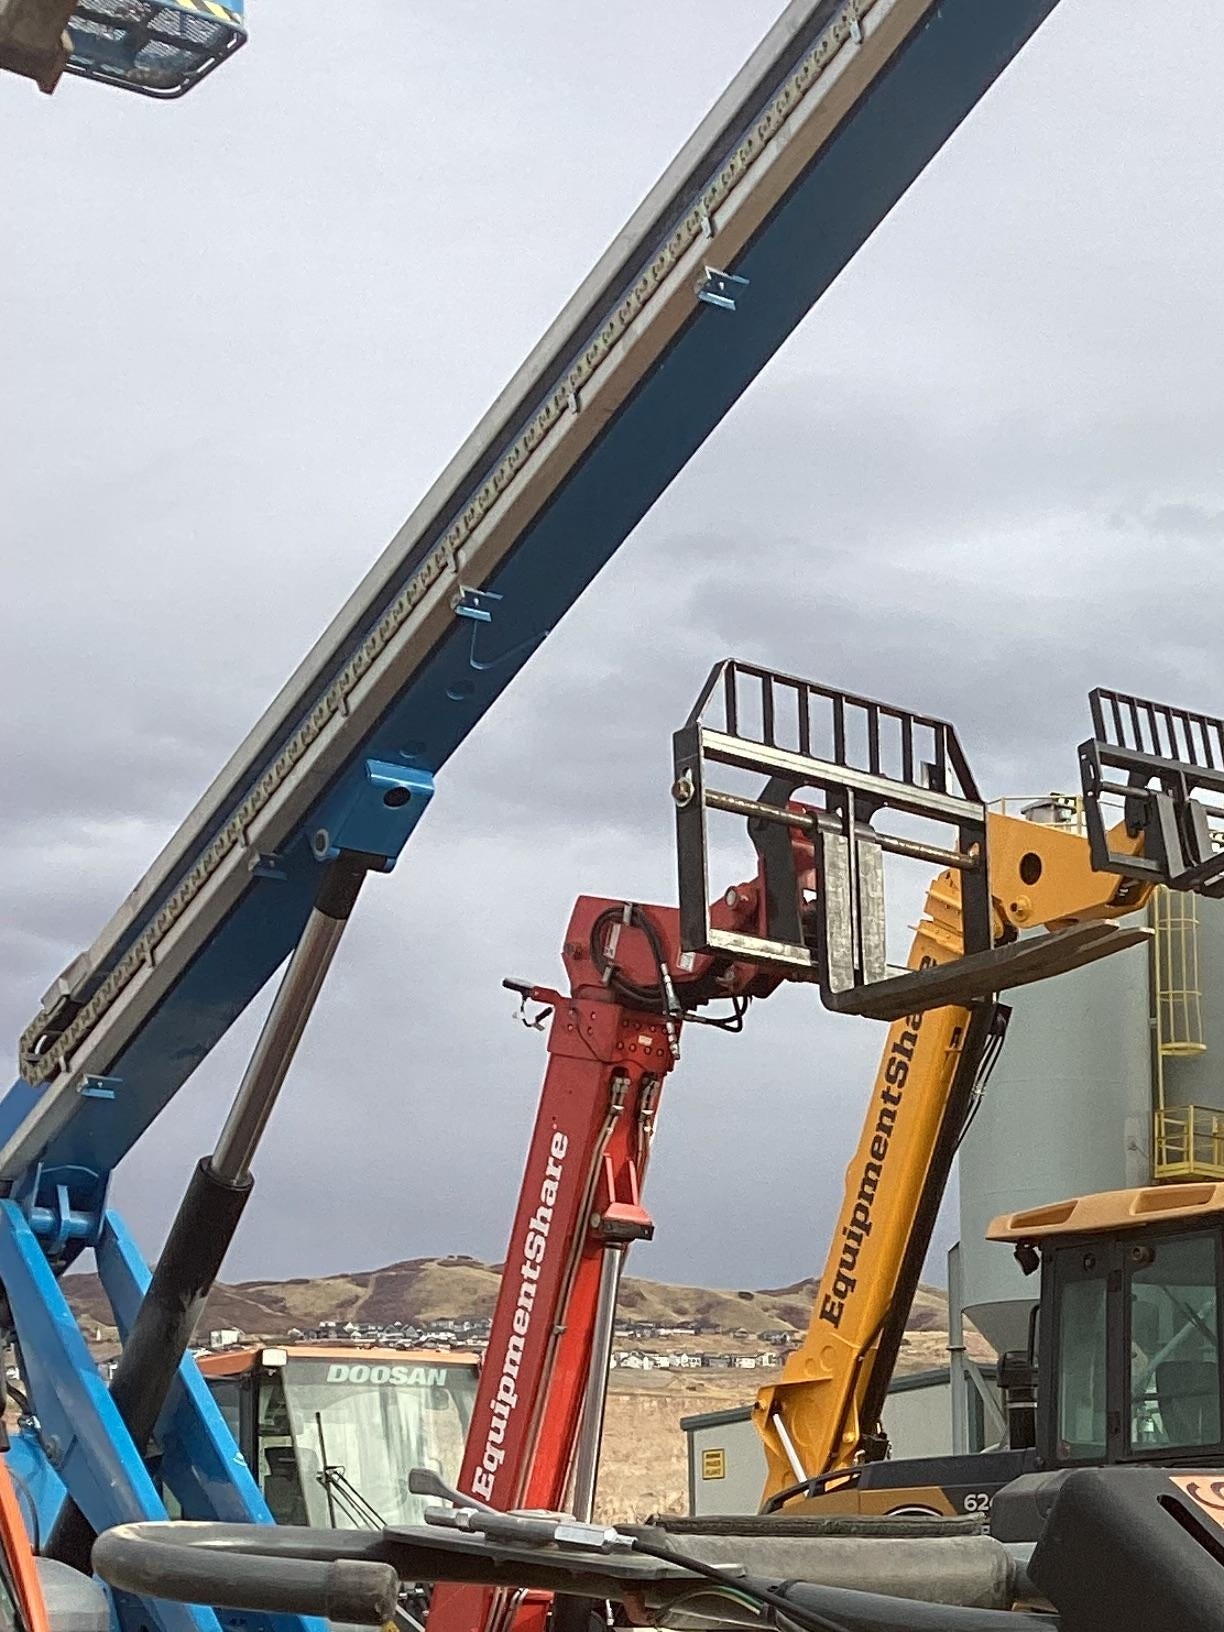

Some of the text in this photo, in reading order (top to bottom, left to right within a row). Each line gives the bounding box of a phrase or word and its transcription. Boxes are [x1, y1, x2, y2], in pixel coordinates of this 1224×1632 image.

[819, 955, 938, 1328] EquipmentShae
[327, 1364, 447, 1386] DOOSAN
[471, 1131, 569, 1502] EquipmentShare
[963, 1493, 995, 1511] 62
